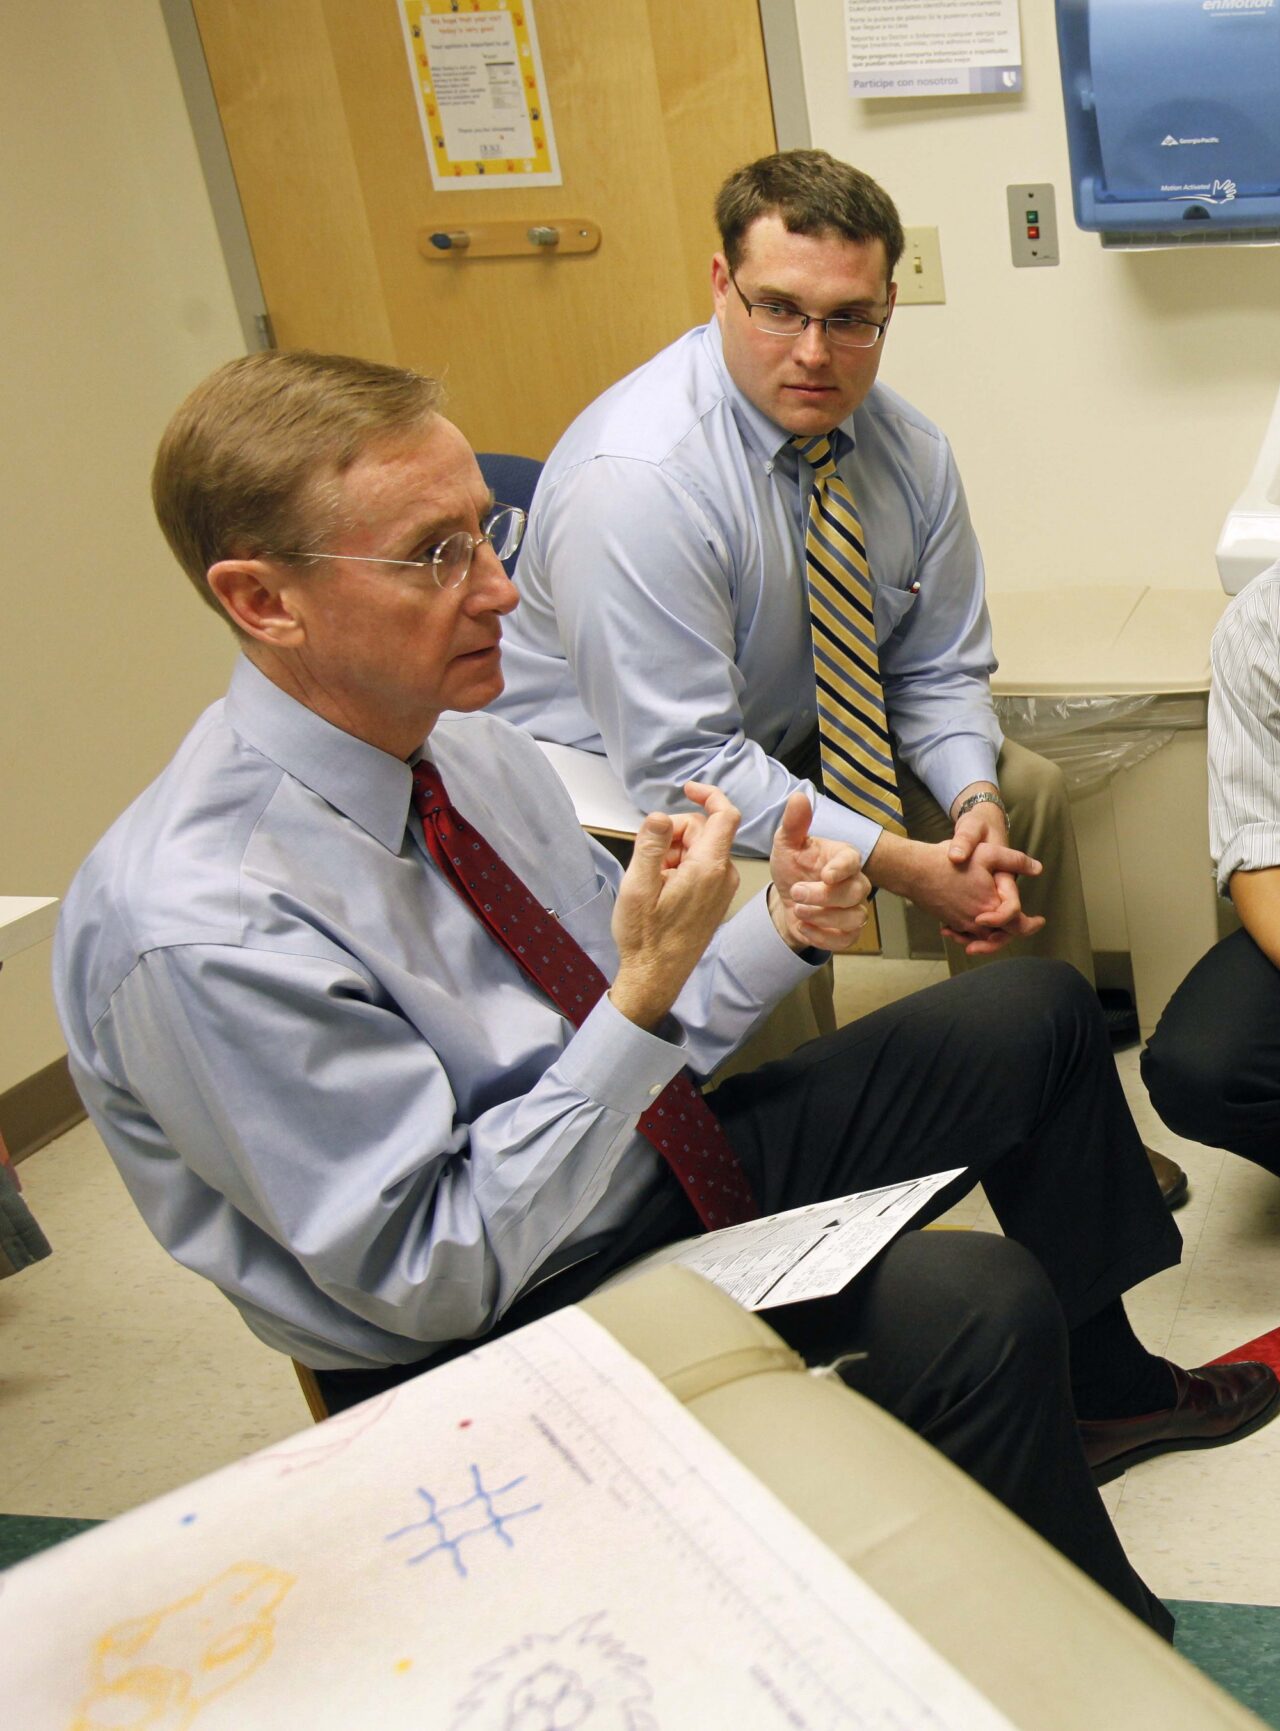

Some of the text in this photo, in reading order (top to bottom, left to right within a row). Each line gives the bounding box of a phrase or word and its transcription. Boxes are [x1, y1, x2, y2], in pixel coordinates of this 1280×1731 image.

[853, 76, 959, 90] Participe con nosotros
[1183, 183, 1211, 191] Activated
